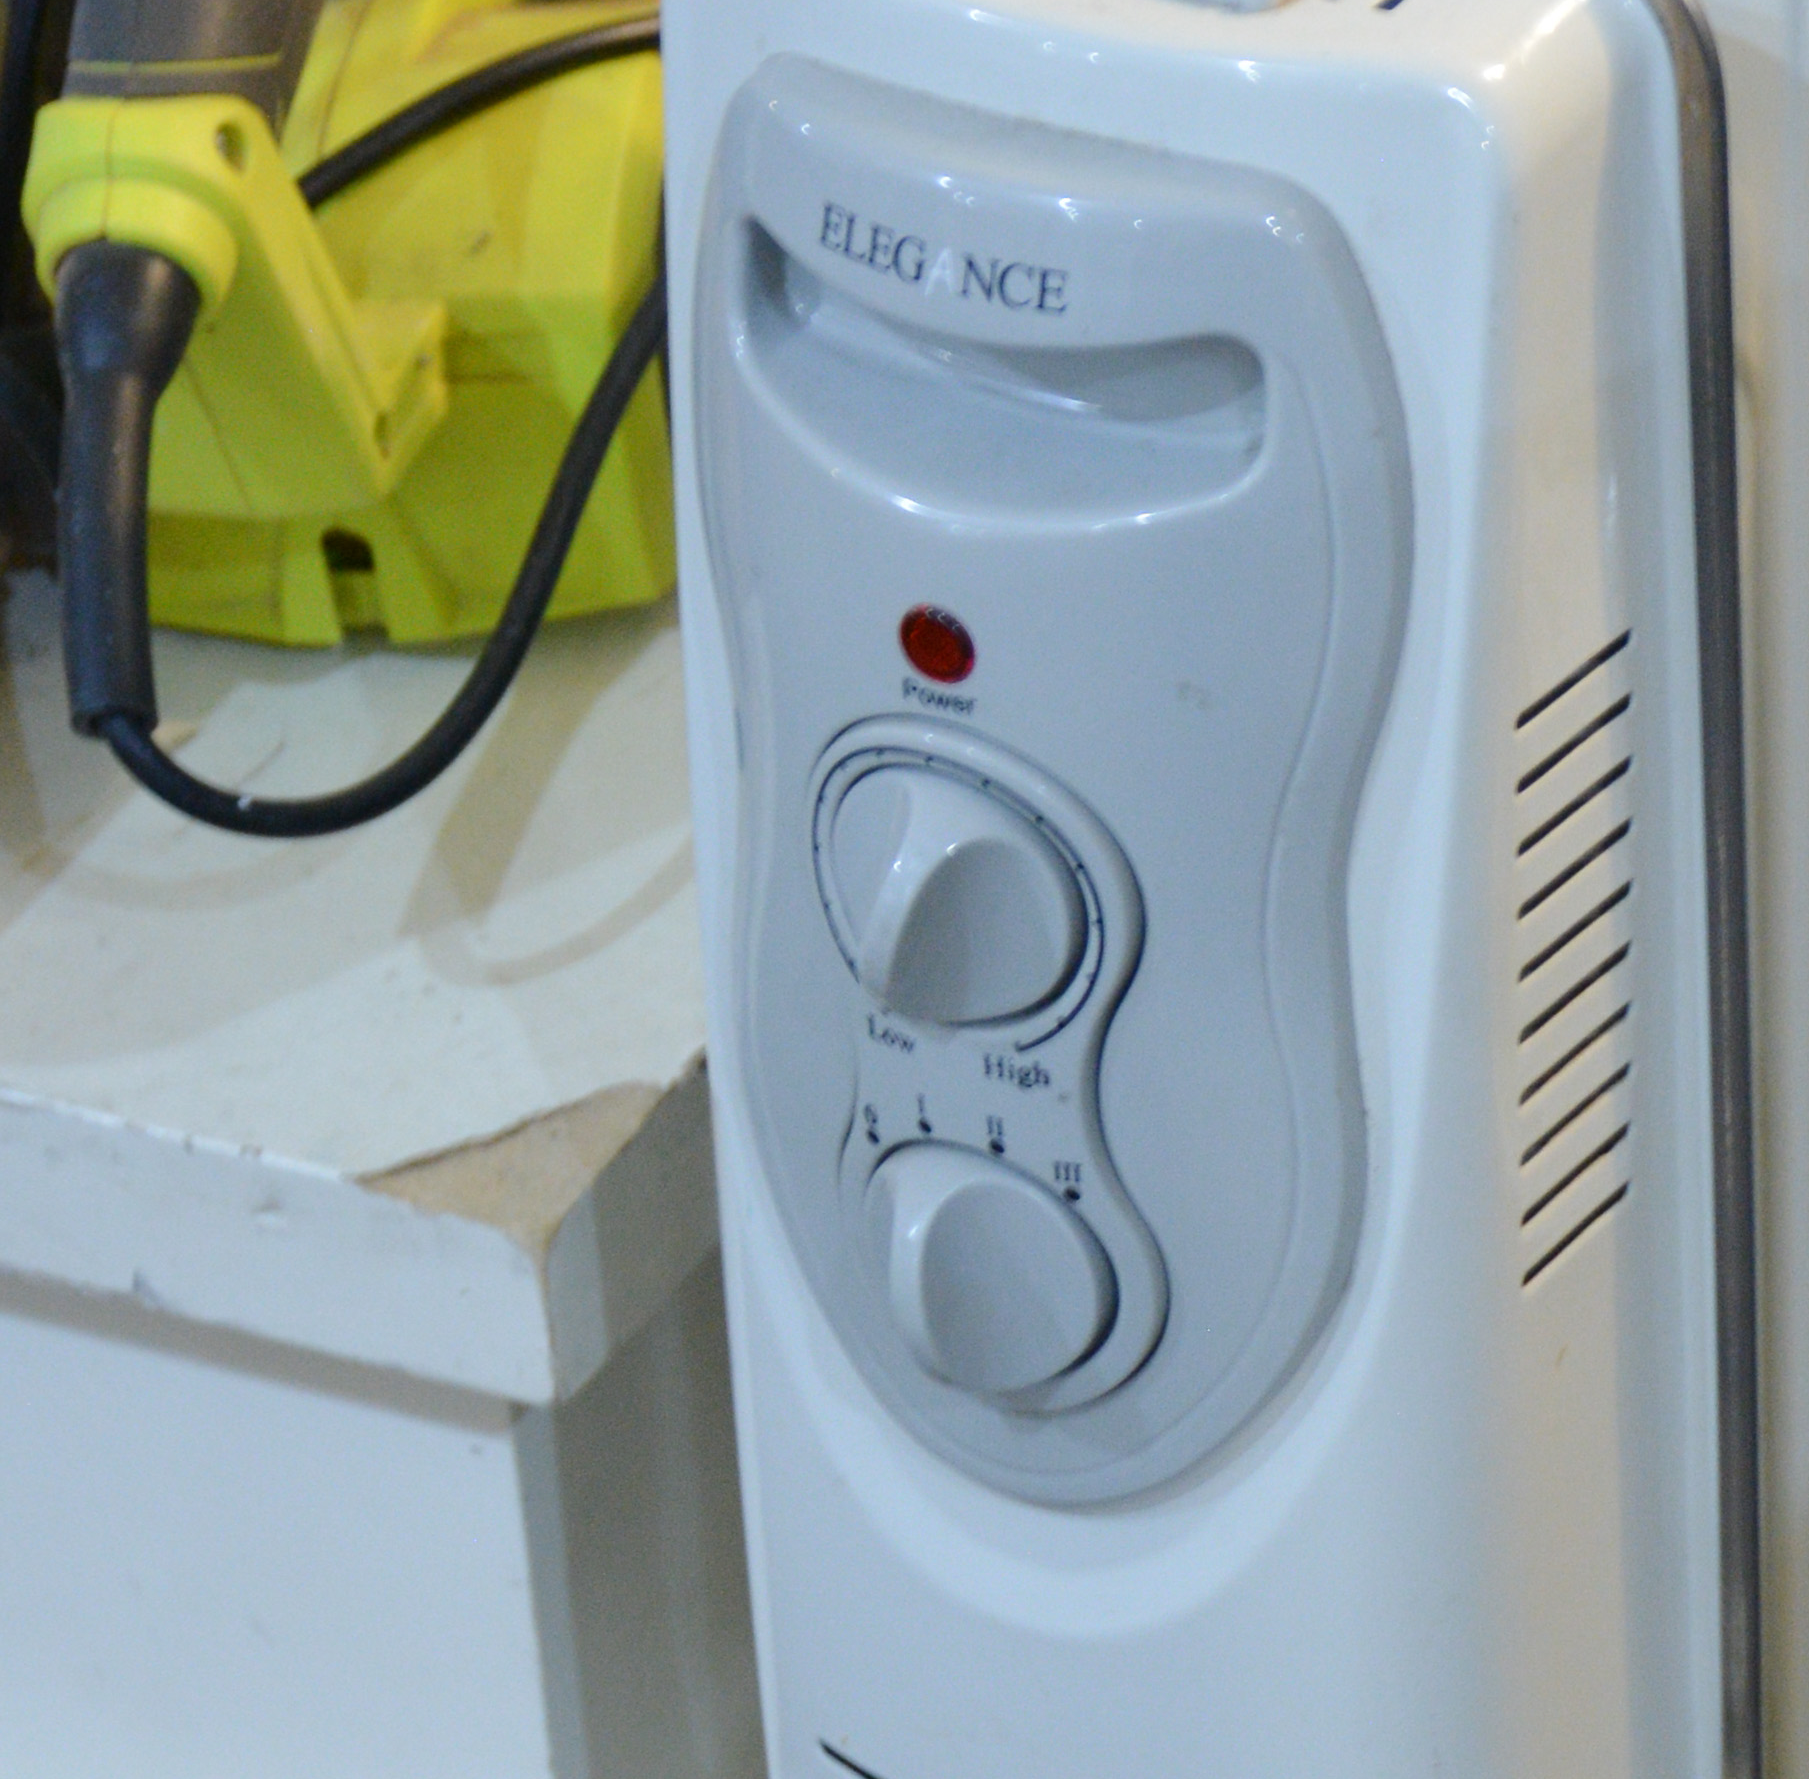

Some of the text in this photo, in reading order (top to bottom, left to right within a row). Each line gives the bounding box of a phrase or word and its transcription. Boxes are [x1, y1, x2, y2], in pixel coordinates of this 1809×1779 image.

[820, 200, 1069, 315] ELEGANCE
[902, 677, 977, 717] Power
[867, 1012, 915, 1054] Low
[983, 1052, 1051, 1090] High
[1054, 1160, 1082, 1184] III
